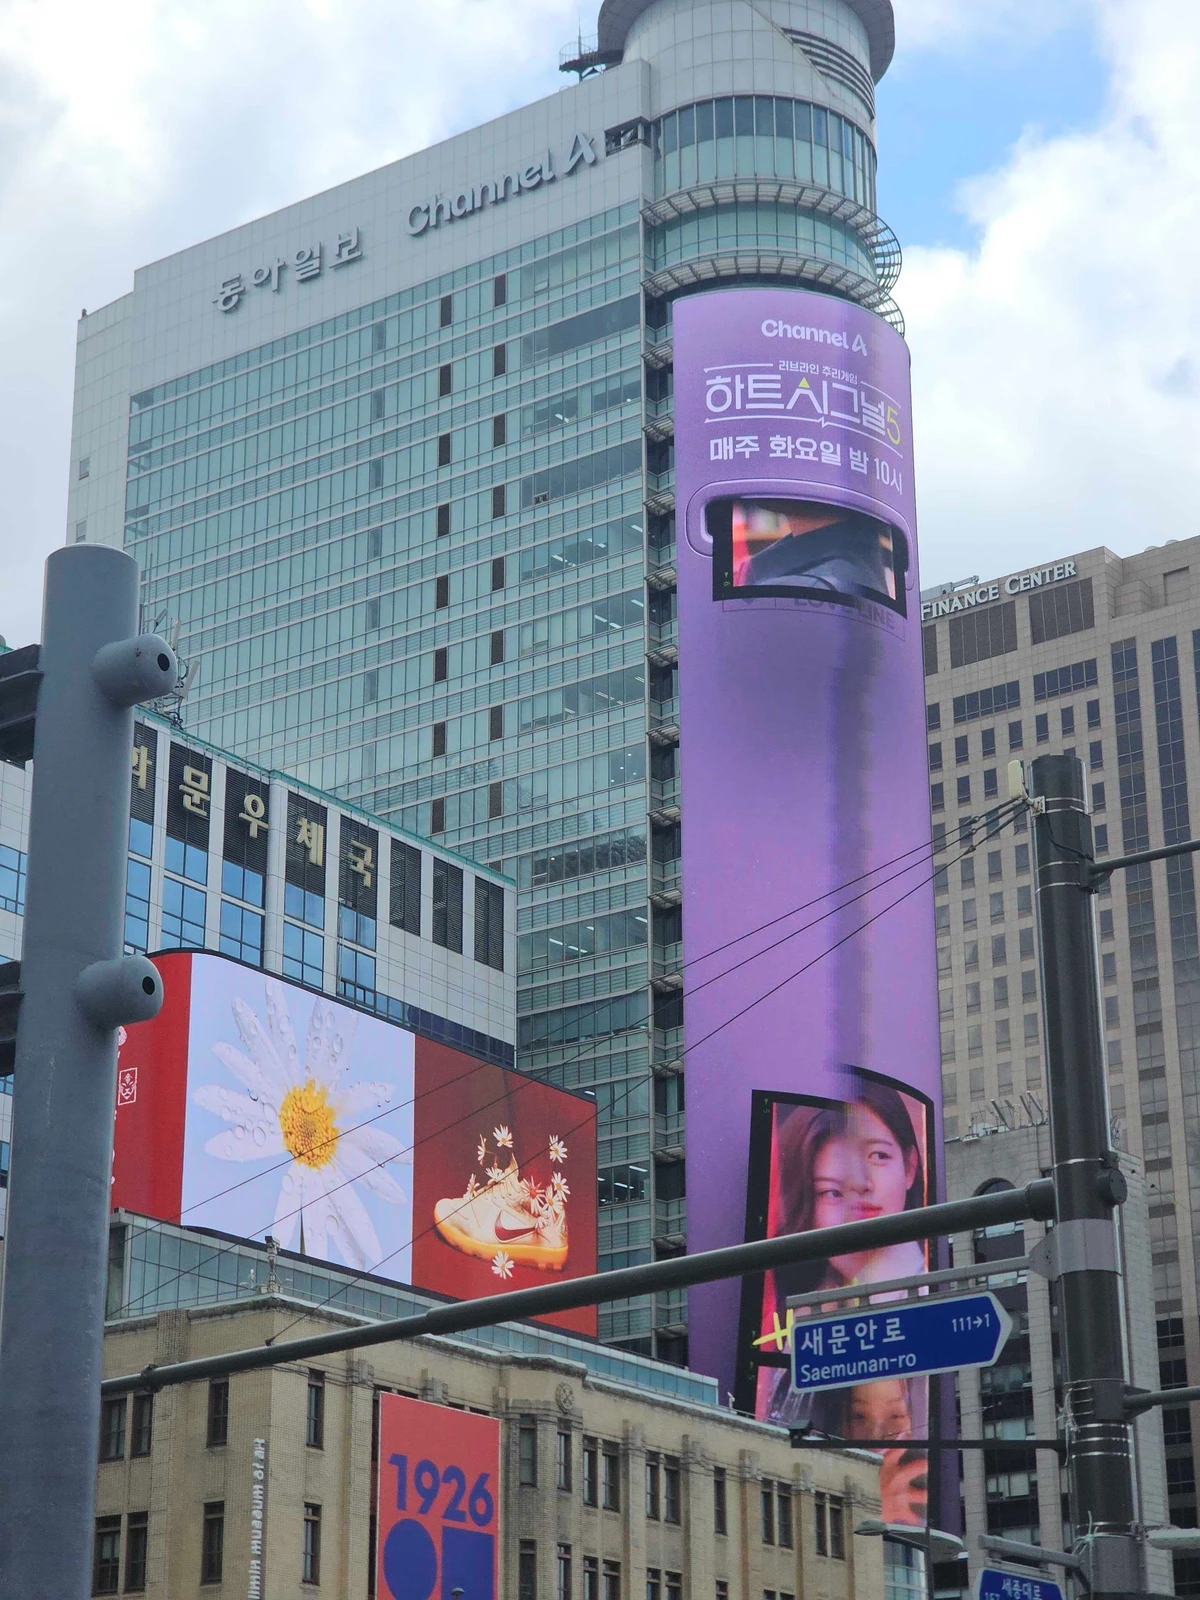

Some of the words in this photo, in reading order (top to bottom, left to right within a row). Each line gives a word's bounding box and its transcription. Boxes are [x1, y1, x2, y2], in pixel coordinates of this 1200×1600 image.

[405, 147, 555, 235] Channel
[562, 130, 596, 174] A
[213, 225, 363, 312] 동아일보
[761, 319, 849, 349] Channel
[851, 334, 868, 357] A
[778, 360, 820, 375] 러브라인
[822, 365, 858, 384] 추리게임
[710, 435, 760, 461] 매주
[769, 434, 842, 466] 화요일
[849, 447, 869, 475] 밤
[874, 457, 903, 495] 10시
[921, 583, 999, 620] FINANCE
[1004, 561, 1077, 595] CENTER
[801, 1317, 906, 1356] 새문안로
[801, 1352, 917, 1383] Saemunan-ro
[253, 1438, 266, 1460] art
[388, 1452, 494, 1527] 1926
